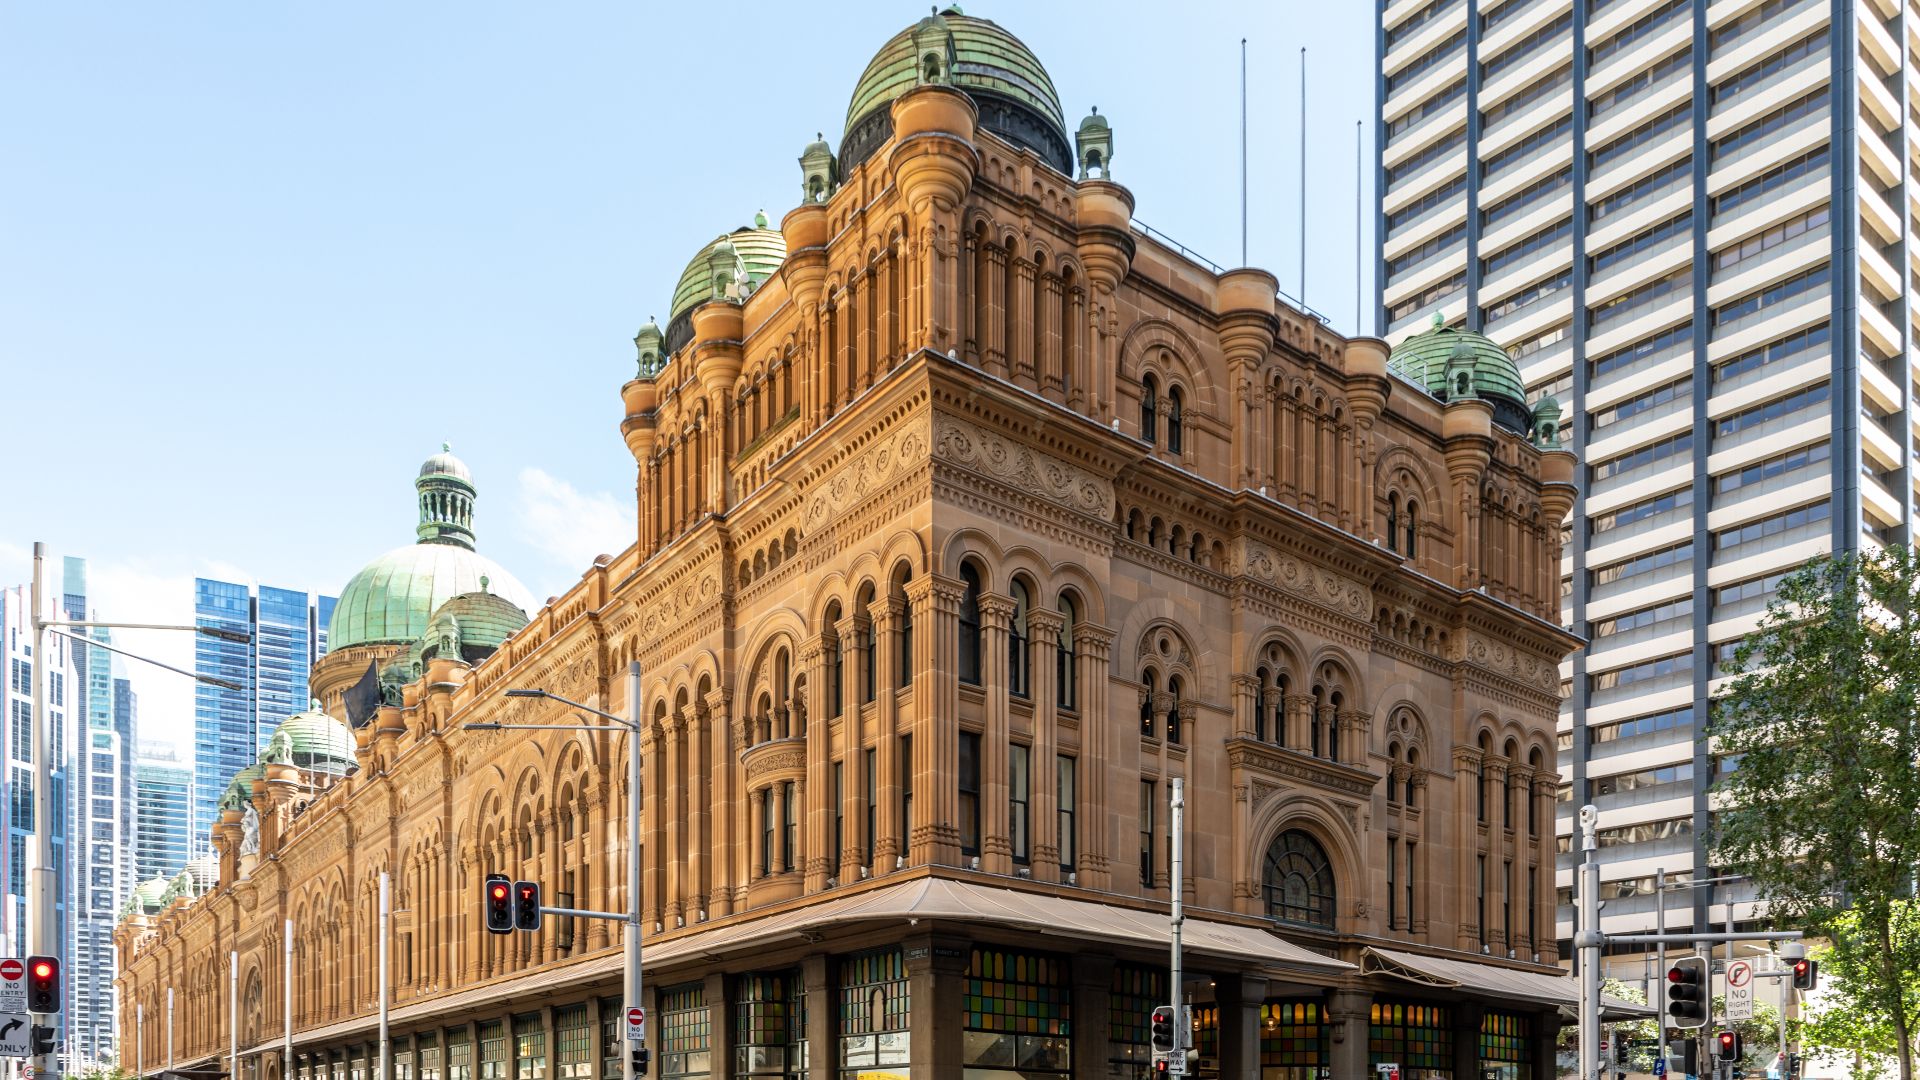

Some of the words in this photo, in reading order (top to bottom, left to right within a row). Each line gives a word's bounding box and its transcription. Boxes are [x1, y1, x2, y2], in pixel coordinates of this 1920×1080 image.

[1731, 989, 1747, 999] NO
[1728, 1000, 1750, 1009] RIGHT
[1729, 1009, 1750, 1017] TURN
